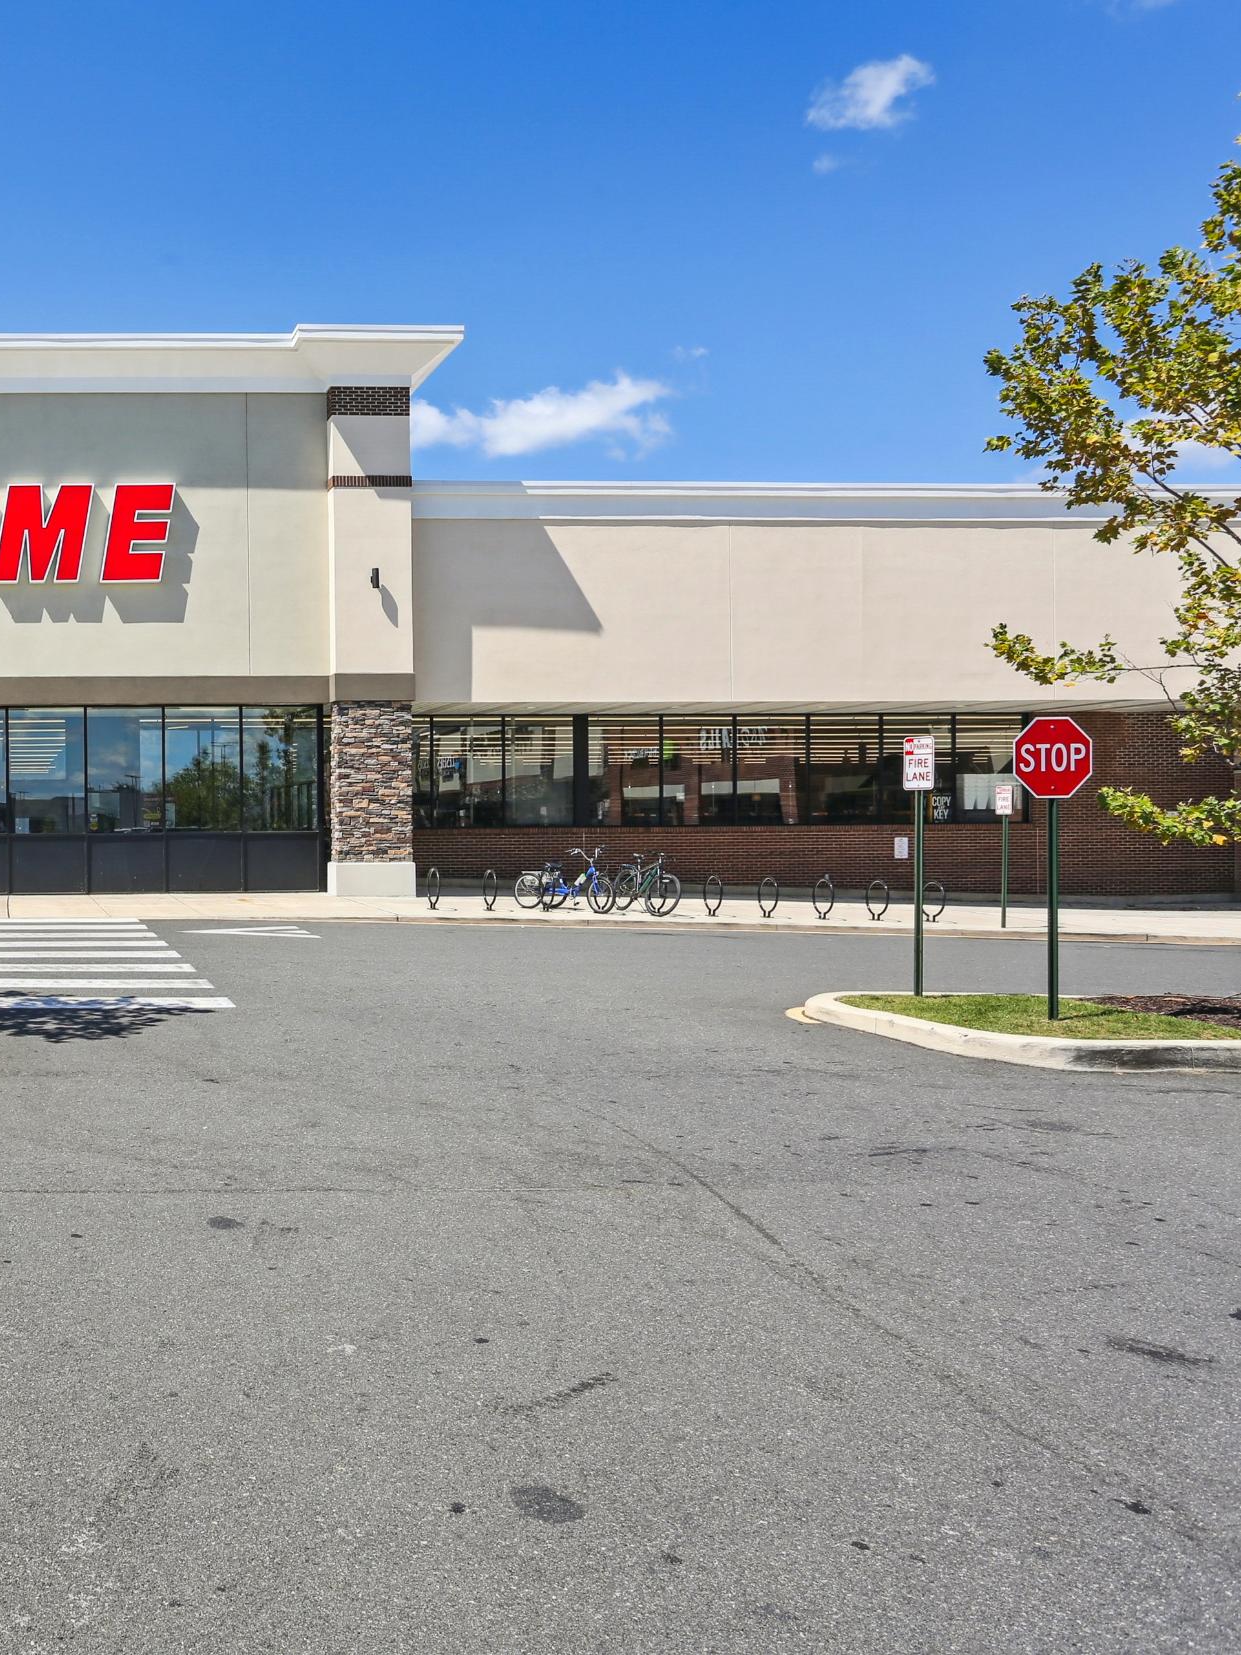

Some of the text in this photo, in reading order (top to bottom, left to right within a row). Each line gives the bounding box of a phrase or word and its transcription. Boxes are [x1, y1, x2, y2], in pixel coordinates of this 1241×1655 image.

[908, 758, 929, 768] FIRE
[1019, 743, 1086, 773] STOP
[906, 772, 931, 781] LANE
[932, 796, 952, 806] COPY
[933, 809, 949, 819] KEY
